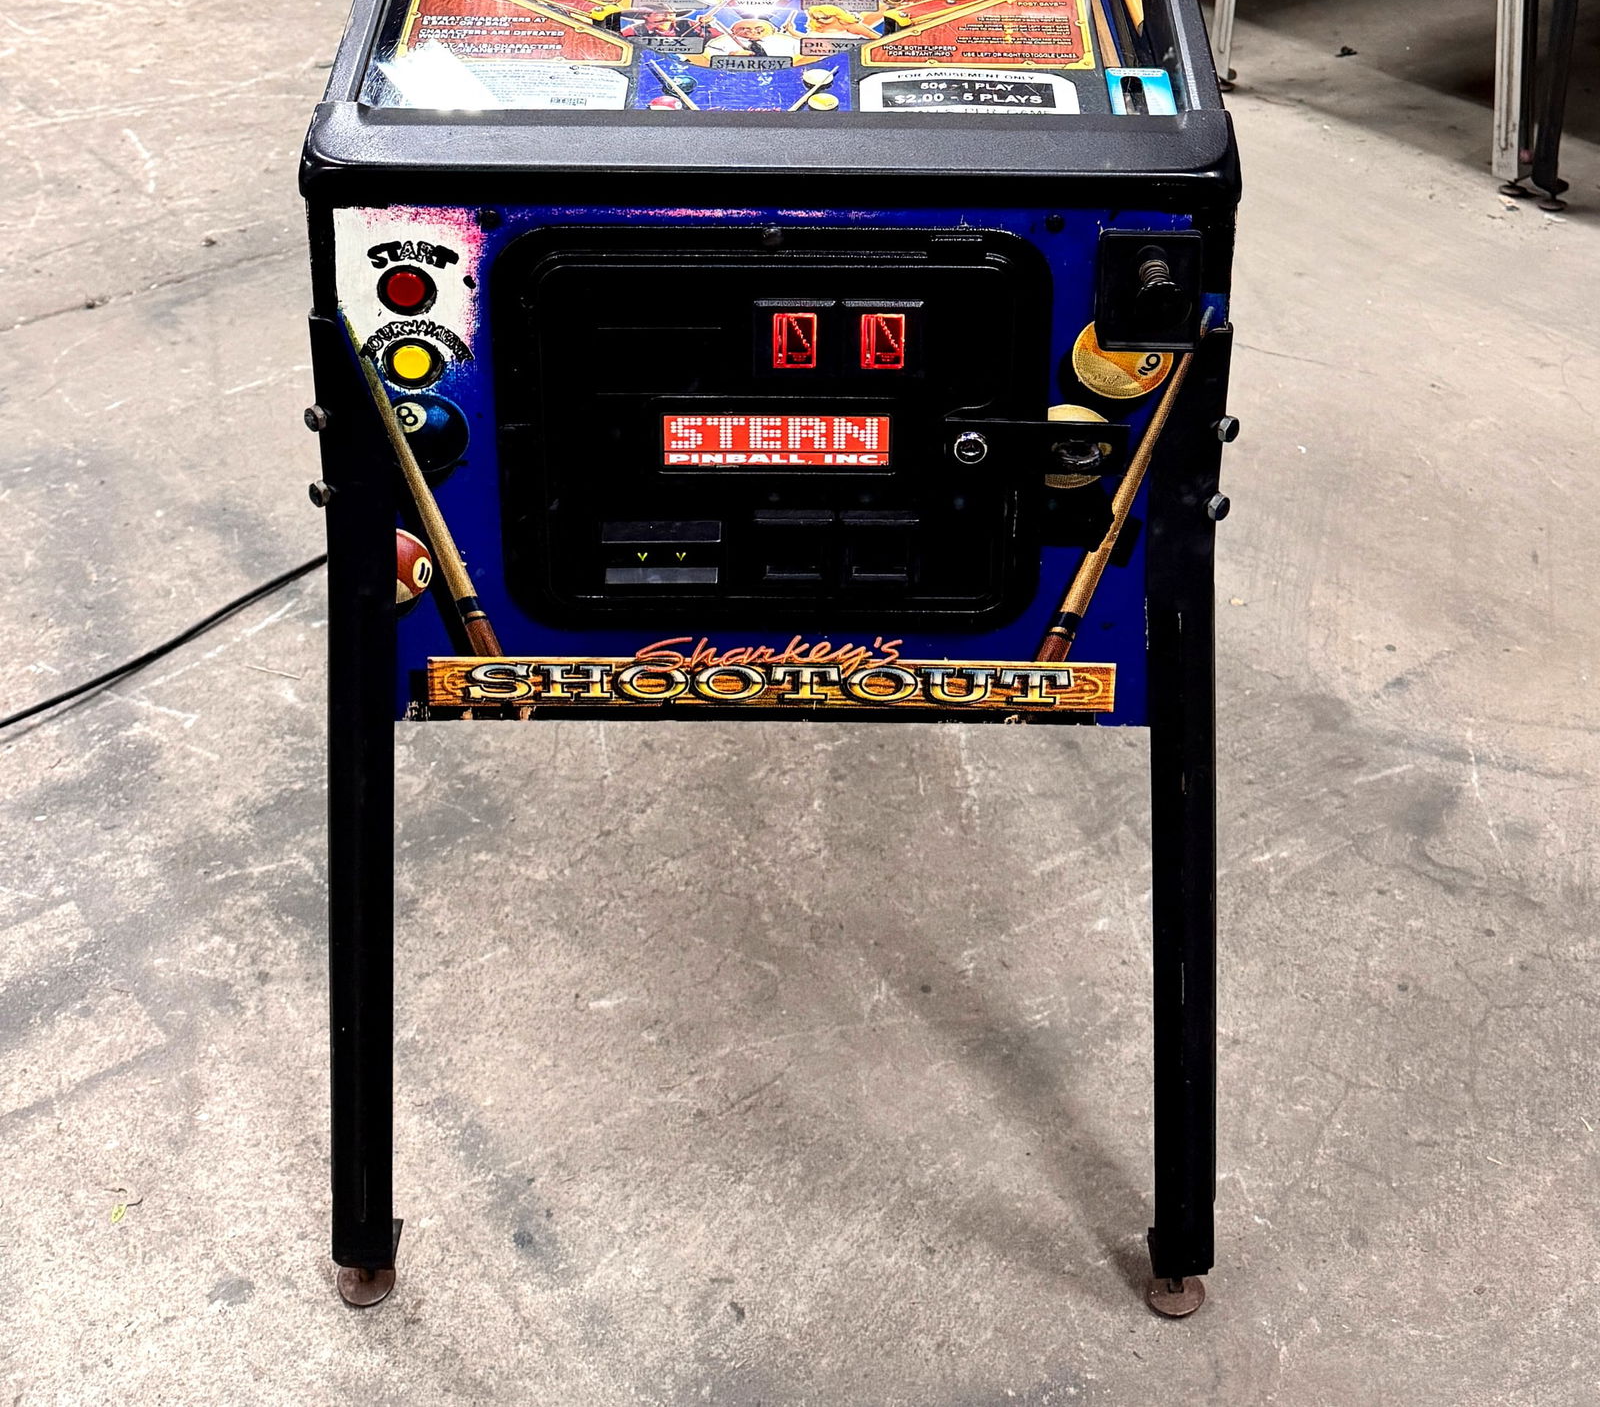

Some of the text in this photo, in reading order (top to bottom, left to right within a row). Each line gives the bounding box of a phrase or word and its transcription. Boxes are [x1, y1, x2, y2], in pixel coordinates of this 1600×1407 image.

[642, 37, 688, 47] TEX
[716, 59, 786, 70] SHARKEY
[962, 82, 969, 90] 1
[975, 82, 1015, 92] PLAY
[894, 93, 945, 105] $2.00
[963, 92, 974, 102] 5
[979, 93, 1043, 104] PLAYS
[366, 240, 460, 270] START
[1137, 353, 1162, 376] 9
[396, 405, 419, 427] 8
[670, 417, 879, 449] STERN
[823, 453, 882, 464] INC.
[417, 561, 431, 584] 11
[636, 635, 903, 674] Sharkey's
[465, 663, 1074, 708] SHOOTOUT
